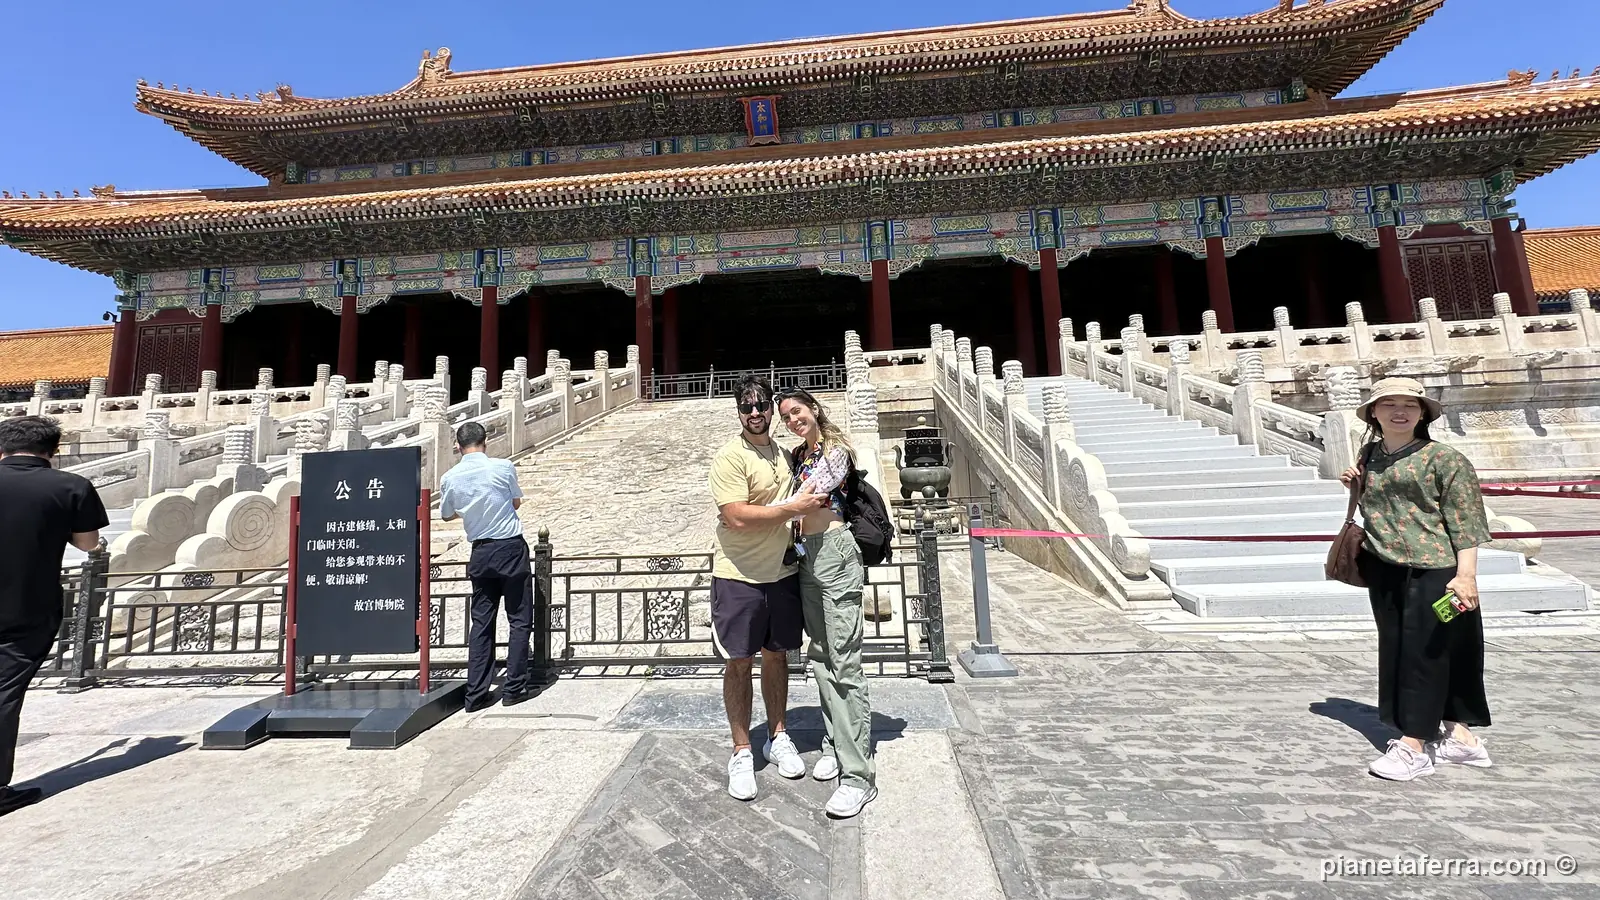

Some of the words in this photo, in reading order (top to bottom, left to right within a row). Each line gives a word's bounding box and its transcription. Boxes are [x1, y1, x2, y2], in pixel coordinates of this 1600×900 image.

[334, 478, 385, 500] 公告
[326, 519, 407, 533] 因古建修缮，太和
[306, 538, 361, 551] 门临时关闭。
[325, 554, 406, 568] 给您参观带来的不
[354, 598, 405, 612] 故宫博物院
